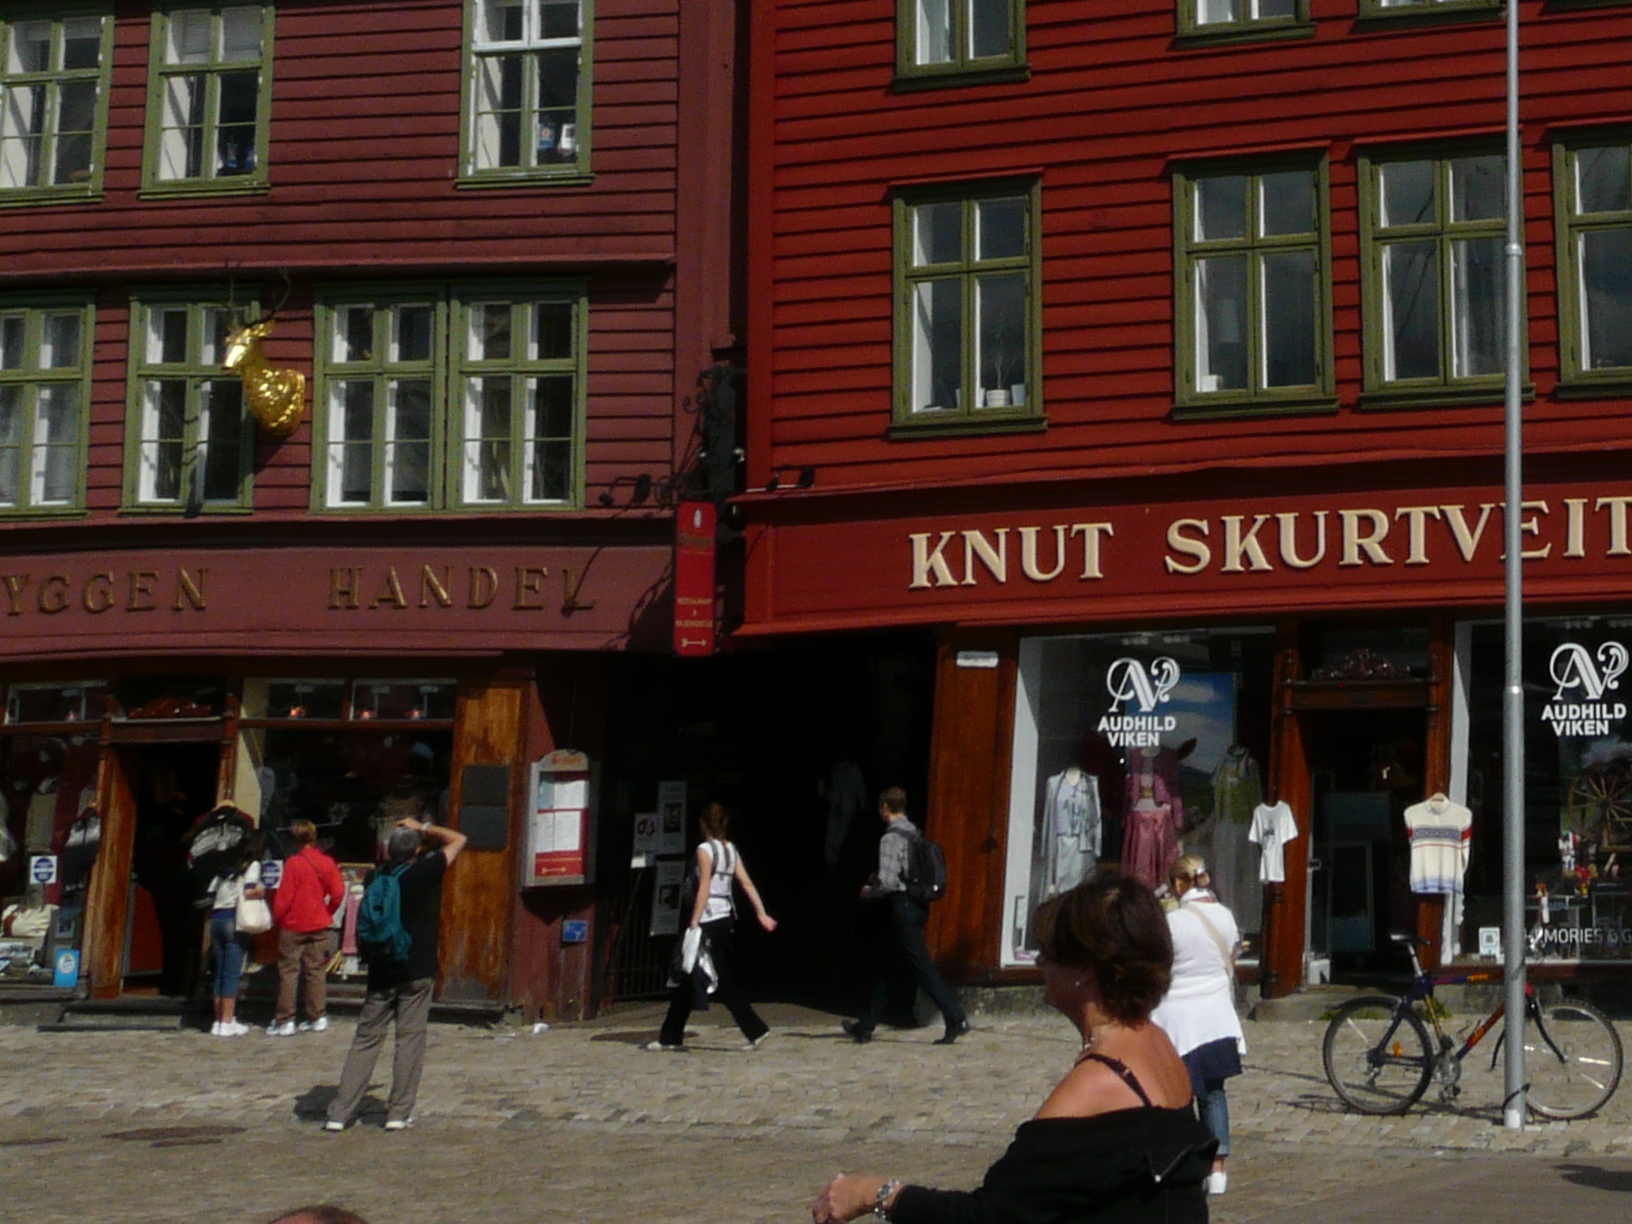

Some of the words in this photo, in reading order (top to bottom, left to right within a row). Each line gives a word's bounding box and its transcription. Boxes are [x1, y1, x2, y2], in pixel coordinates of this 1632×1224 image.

[908, 522, 1114, 589] KNUT
[327, 564, 596, 612] HANDEL
[1541, 703, 1627, 720] AUDHILD
[1097, 716, 1176, 731] AUDHILD
[1552, 720, 1609, 736] VIKEN
[1107, 732, 1160, 747] VIKEN
